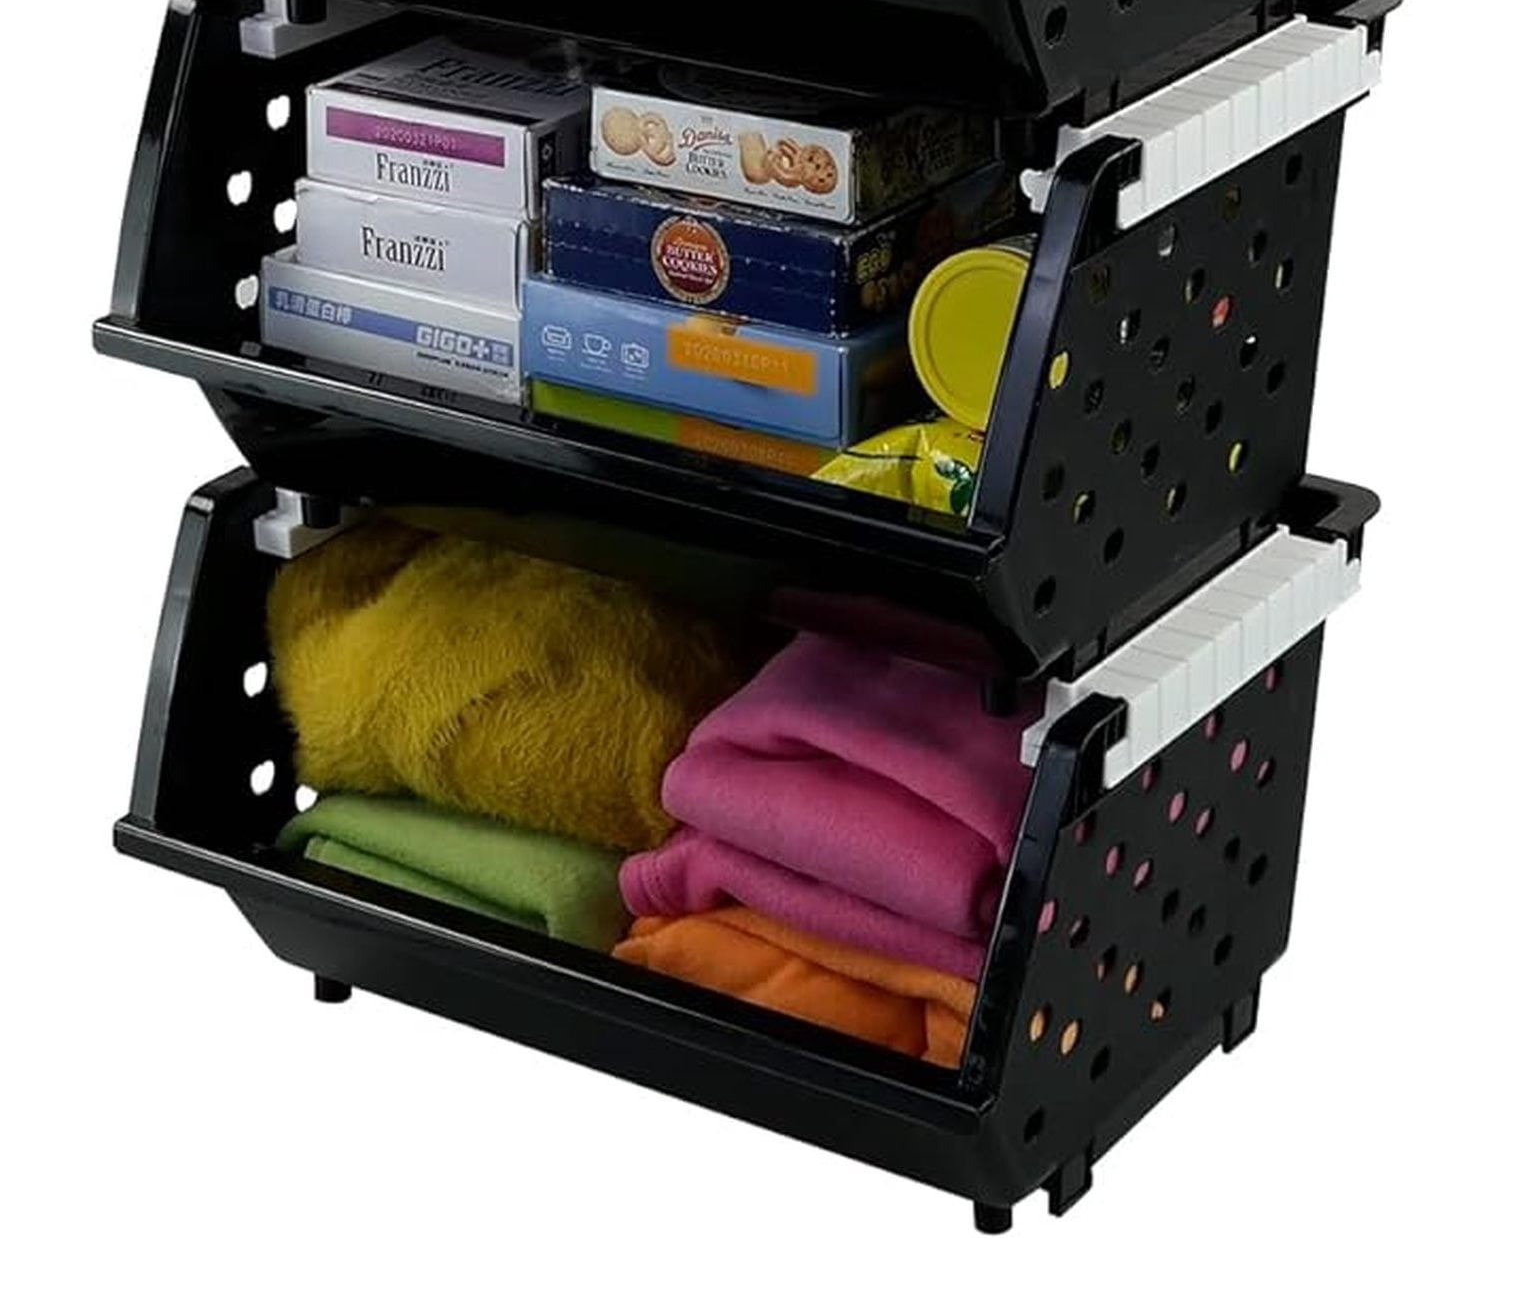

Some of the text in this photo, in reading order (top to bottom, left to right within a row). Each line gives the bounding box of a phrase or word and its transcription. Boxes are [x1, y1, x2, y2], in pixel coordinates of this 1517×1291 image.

[376, 152, 451, 193] Franzzi
[362, 226, 445, 272] Franzzi
[666, 244, 715, 265] BUTTER
